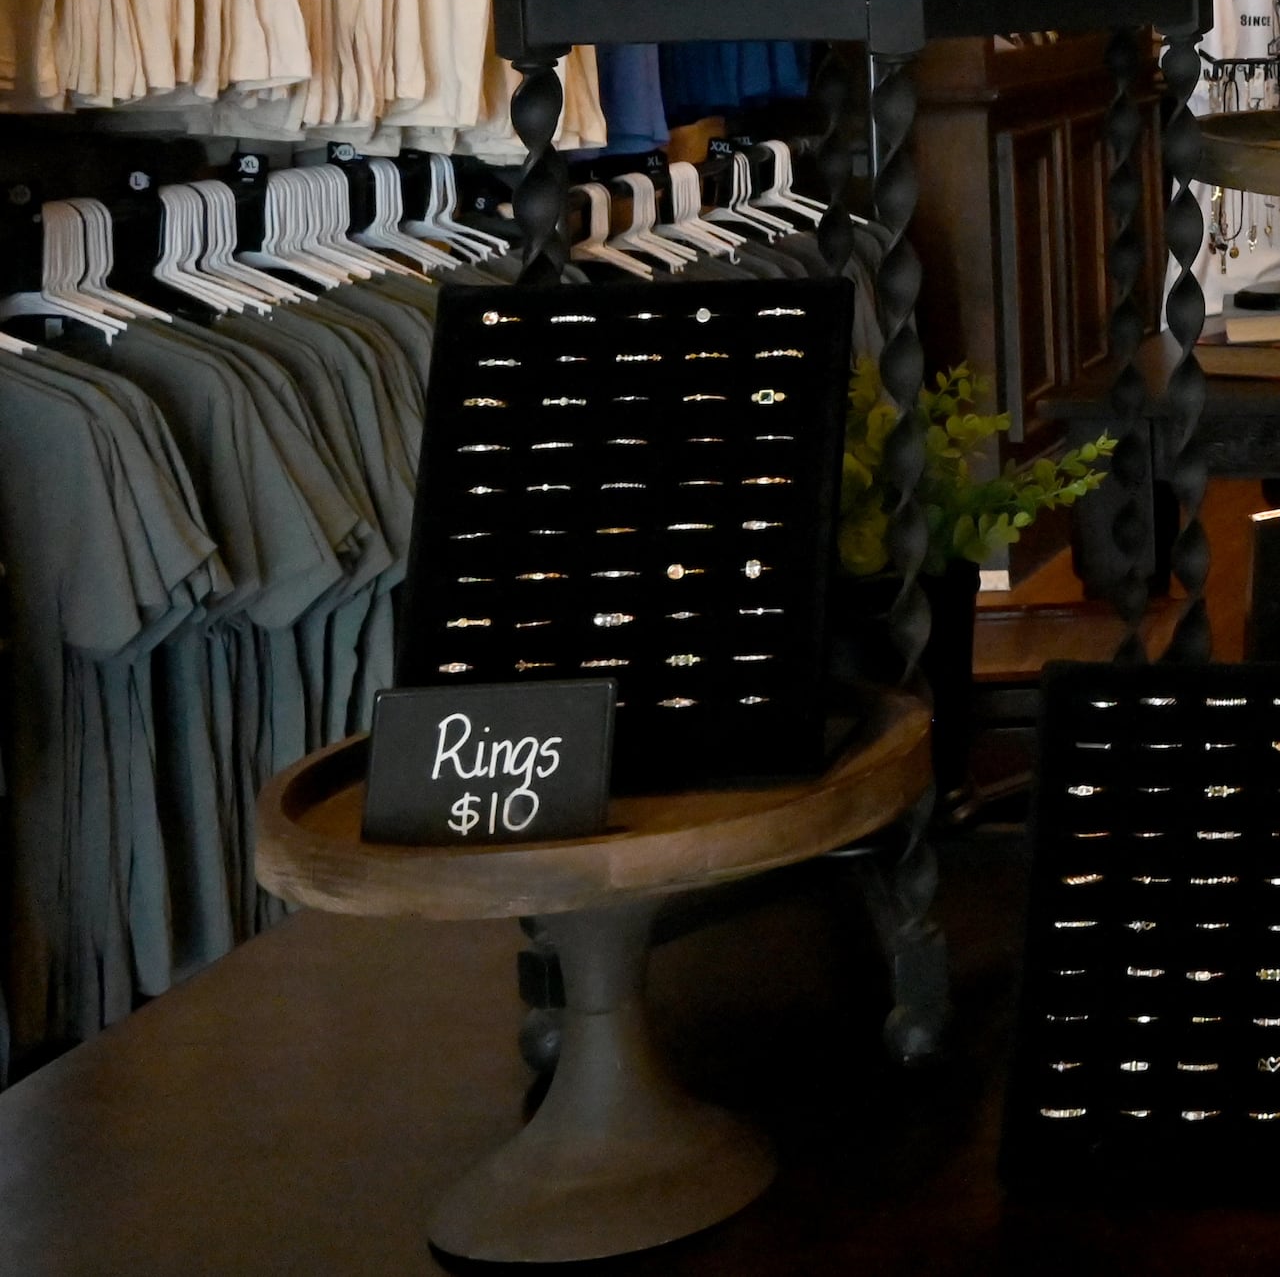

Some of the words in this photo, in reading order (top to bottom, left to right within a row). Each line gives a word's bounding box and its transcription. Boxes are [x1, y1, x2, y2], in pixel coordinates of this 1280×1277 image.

[710, 140, 732, 154] XXL
[475, 197, 486, 209] S
[431, 713, 563, 791] Rings
[448, 788, 540, 836] $10
